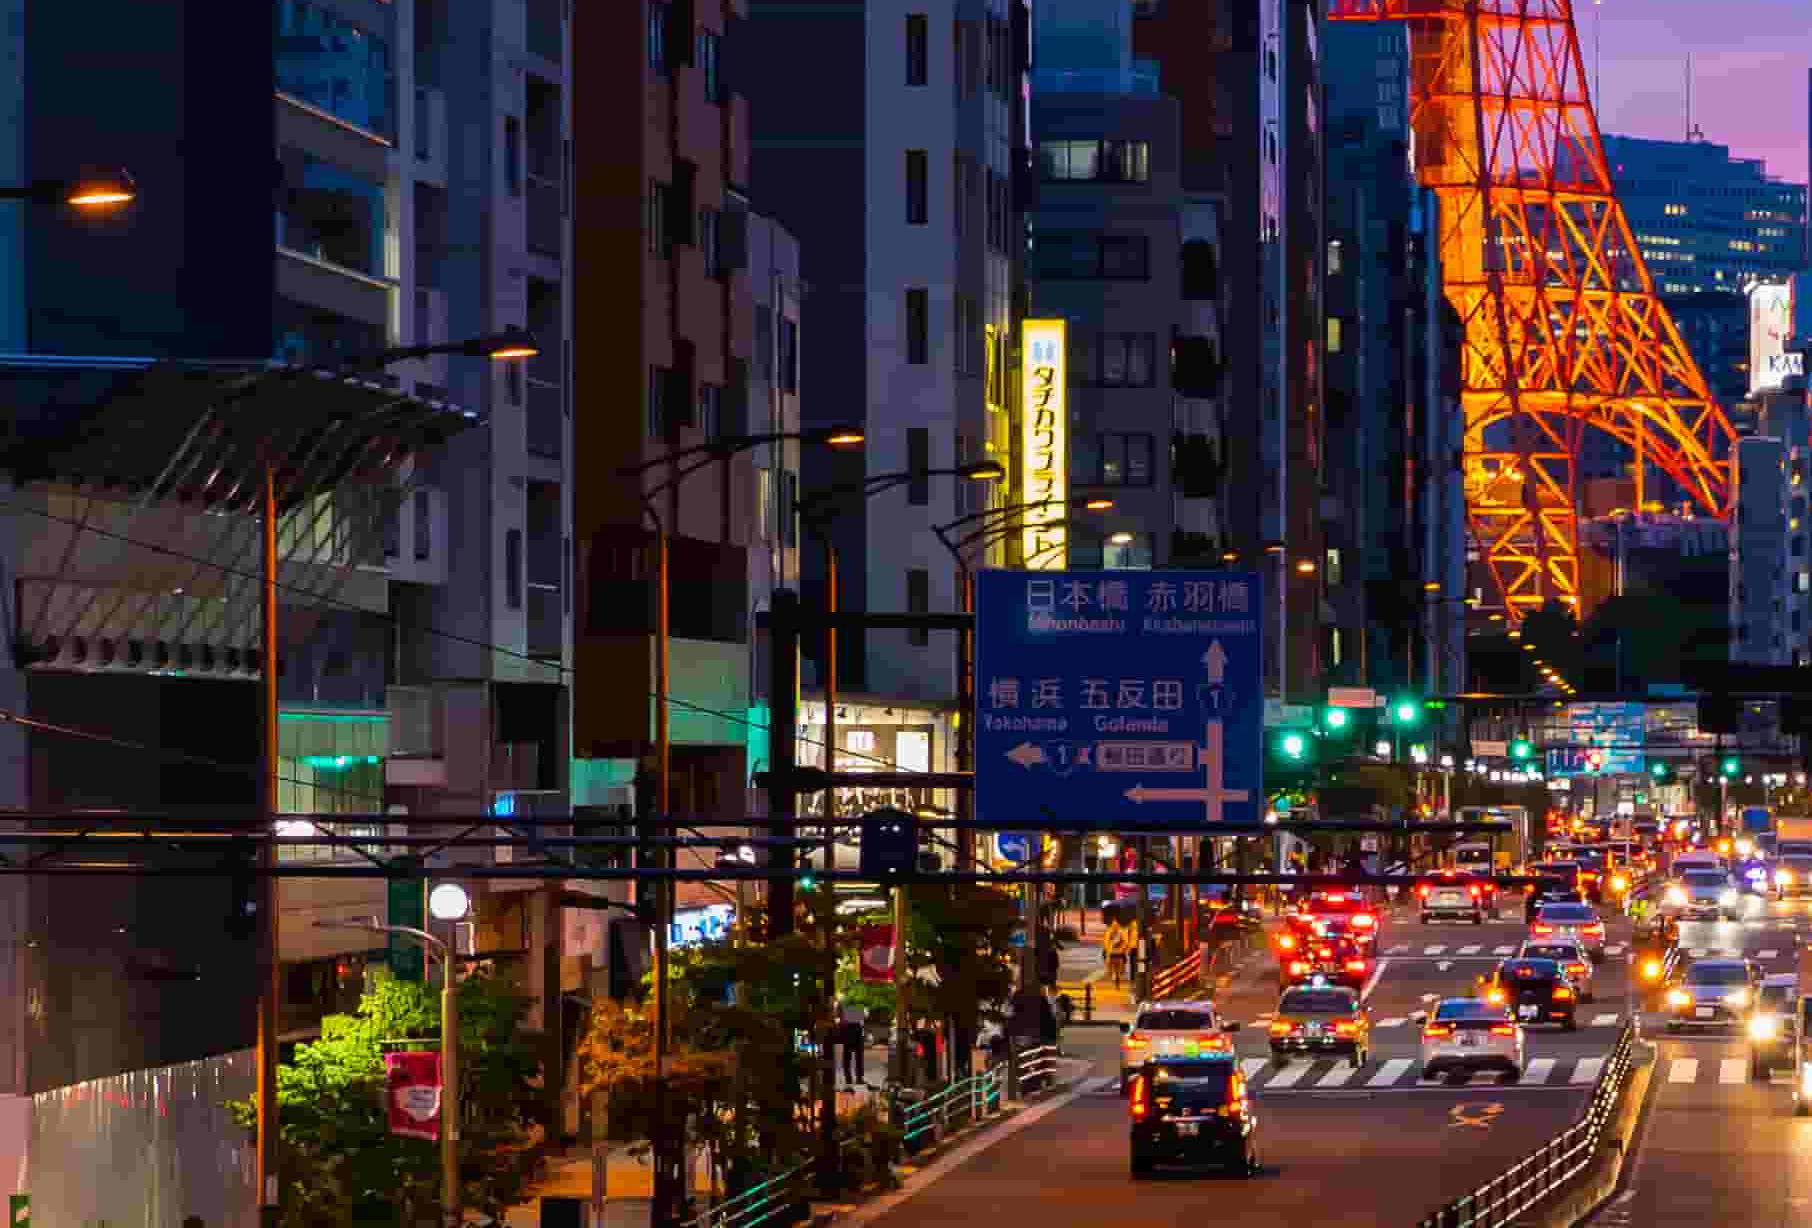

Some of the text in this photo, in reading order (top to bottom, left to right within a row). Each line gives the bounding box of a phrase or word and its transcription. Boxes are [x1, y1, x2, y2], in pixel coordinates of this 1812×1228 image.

[1027, 578, 1250, 613] 日本橋 赤羽橋
[989, 676, 1184, 710] 横浜 五反田
[984, 714, 1169, 733] Yokohama Gotanda
